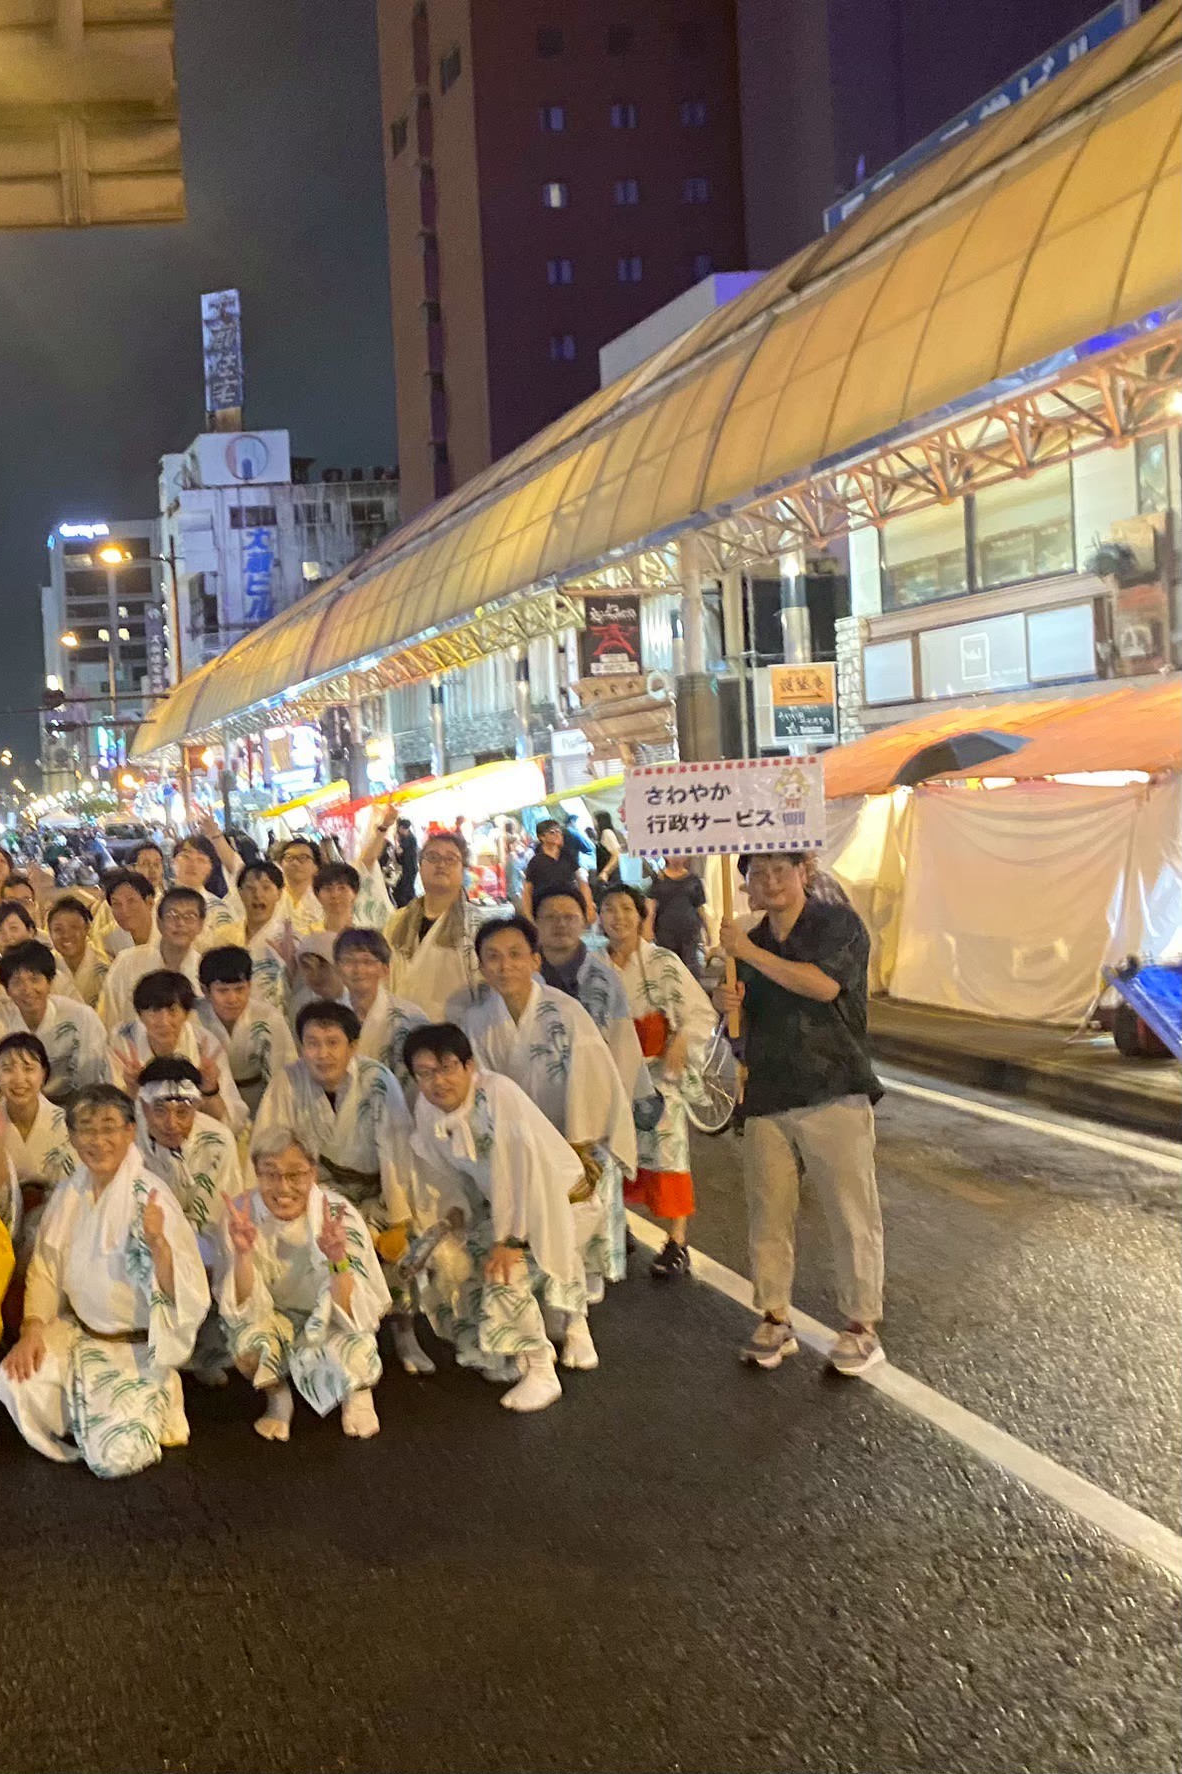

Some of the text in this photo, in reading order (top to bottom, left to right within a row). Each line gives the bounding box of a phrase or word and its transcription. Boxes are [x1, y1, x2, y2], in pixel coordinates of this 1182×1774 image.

[645, 782, 732, 805] さわやか
[646, 809, 775, 834] 行政サービス
